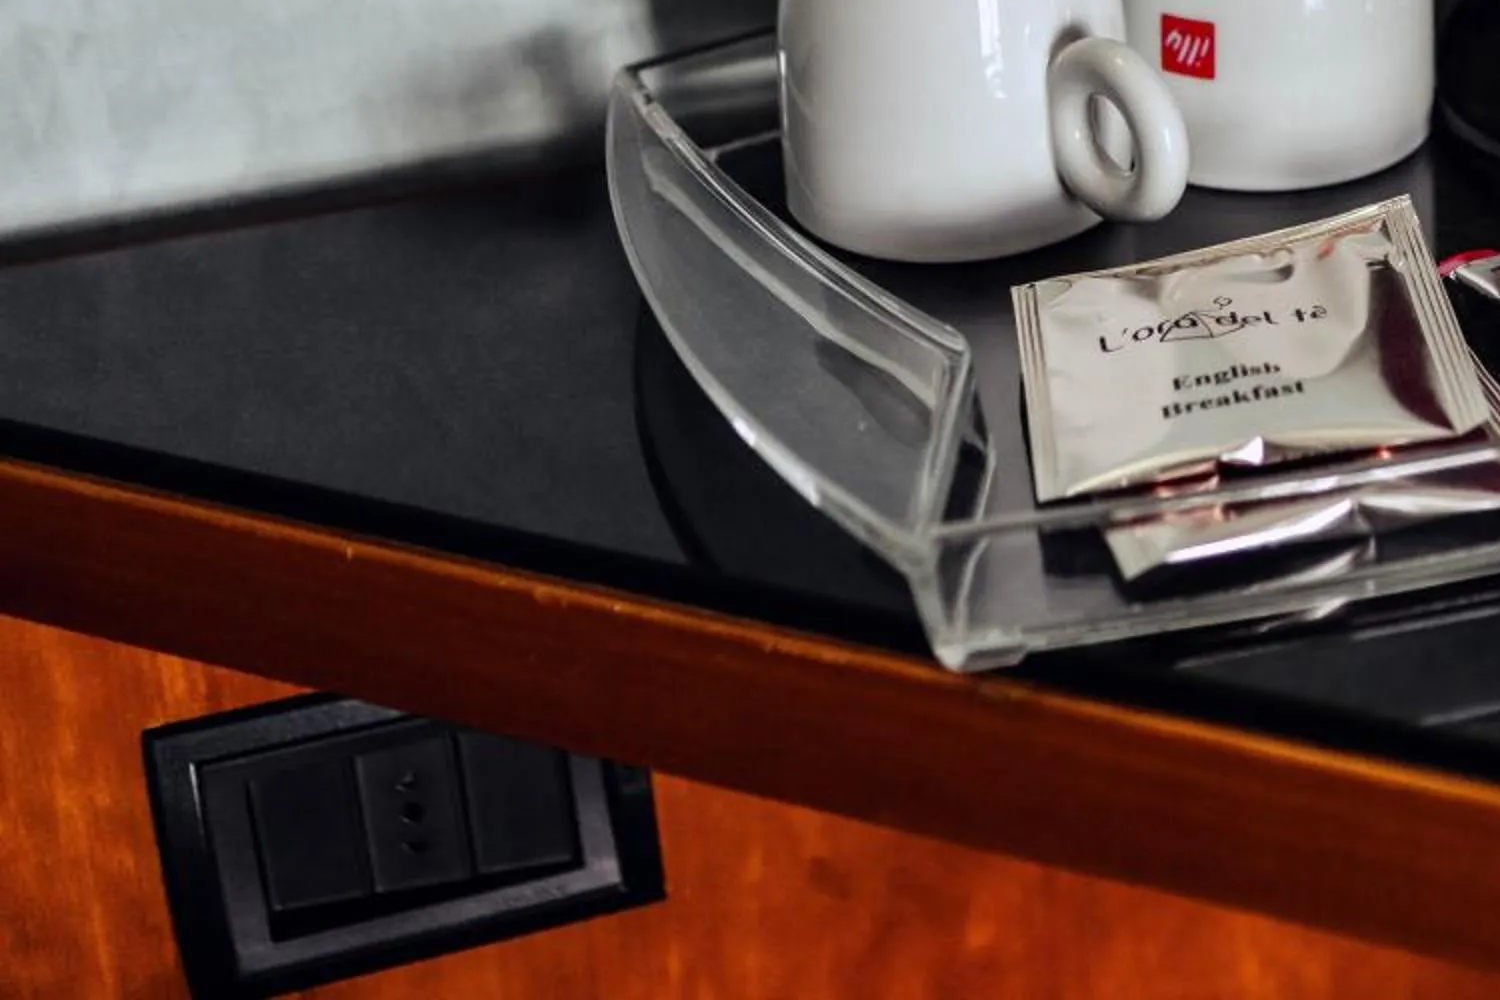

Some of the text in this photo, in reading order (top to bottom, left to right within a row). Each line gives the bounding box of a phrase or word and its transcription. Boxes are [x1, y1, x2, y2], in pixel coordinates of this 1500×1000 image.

[1165, 29, 1211, 69] illy
[1099, 316, 1199, 353] L'ora
[1216, 310, 1279, 328] del
[1172, 362, 1281, 392] English
[1161, 380, 1305, 420] Breakfast
